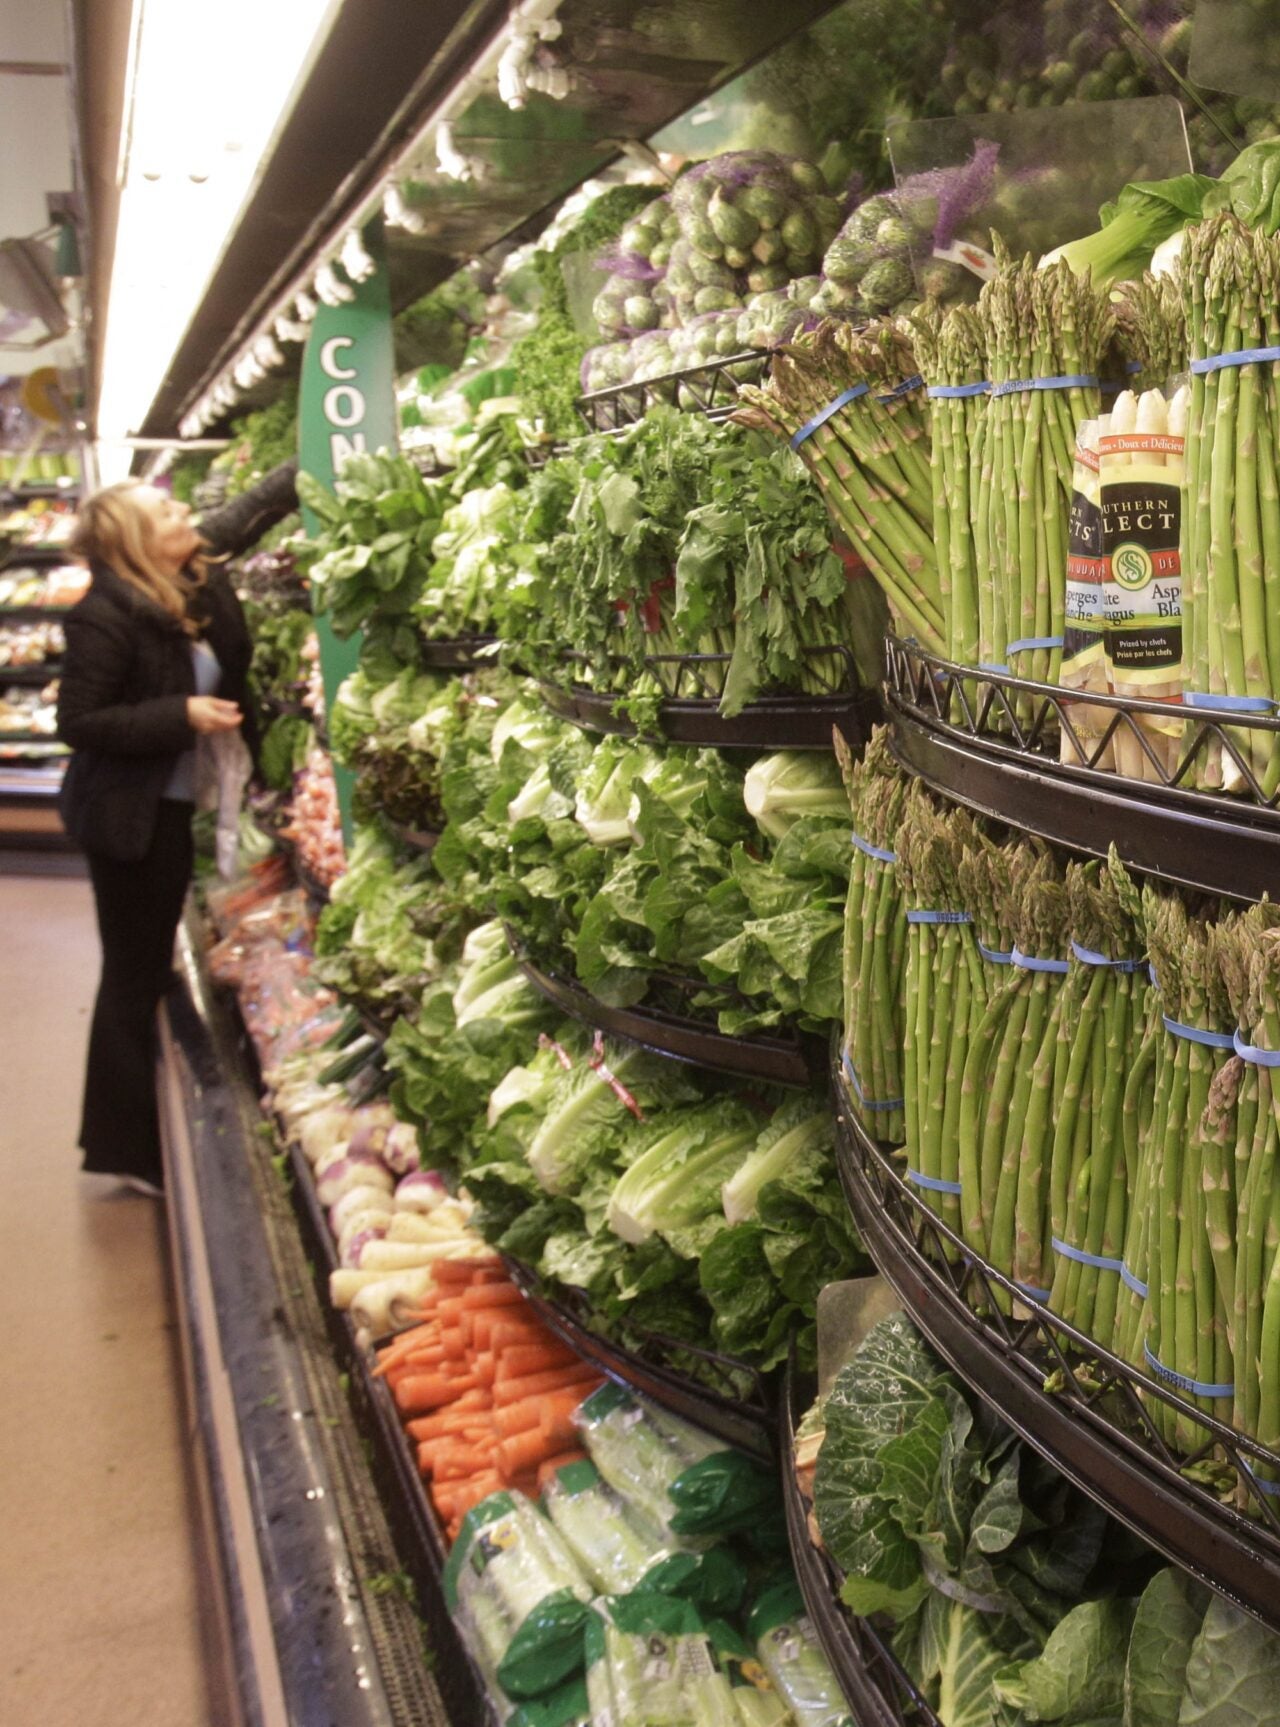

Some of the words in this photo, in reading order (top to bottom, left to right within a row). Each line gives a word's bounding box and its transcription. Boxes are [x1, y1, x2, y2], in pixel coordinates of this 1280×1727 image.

[1118, 438, 1139, 449] Doux
[1151, 437, 1184, 451] Délicieu
[1152, 583, 1181, 603] Asp
[1119, 640, 1140, 648] Prized
[1140, 639, 1148, 648] by
[1149, 637, 1167, 646] chefs
[1134, 650, 1145, 659] par
[1145, 649, 1155, 657] les
[1156, 648, 1173, 657] chefs
